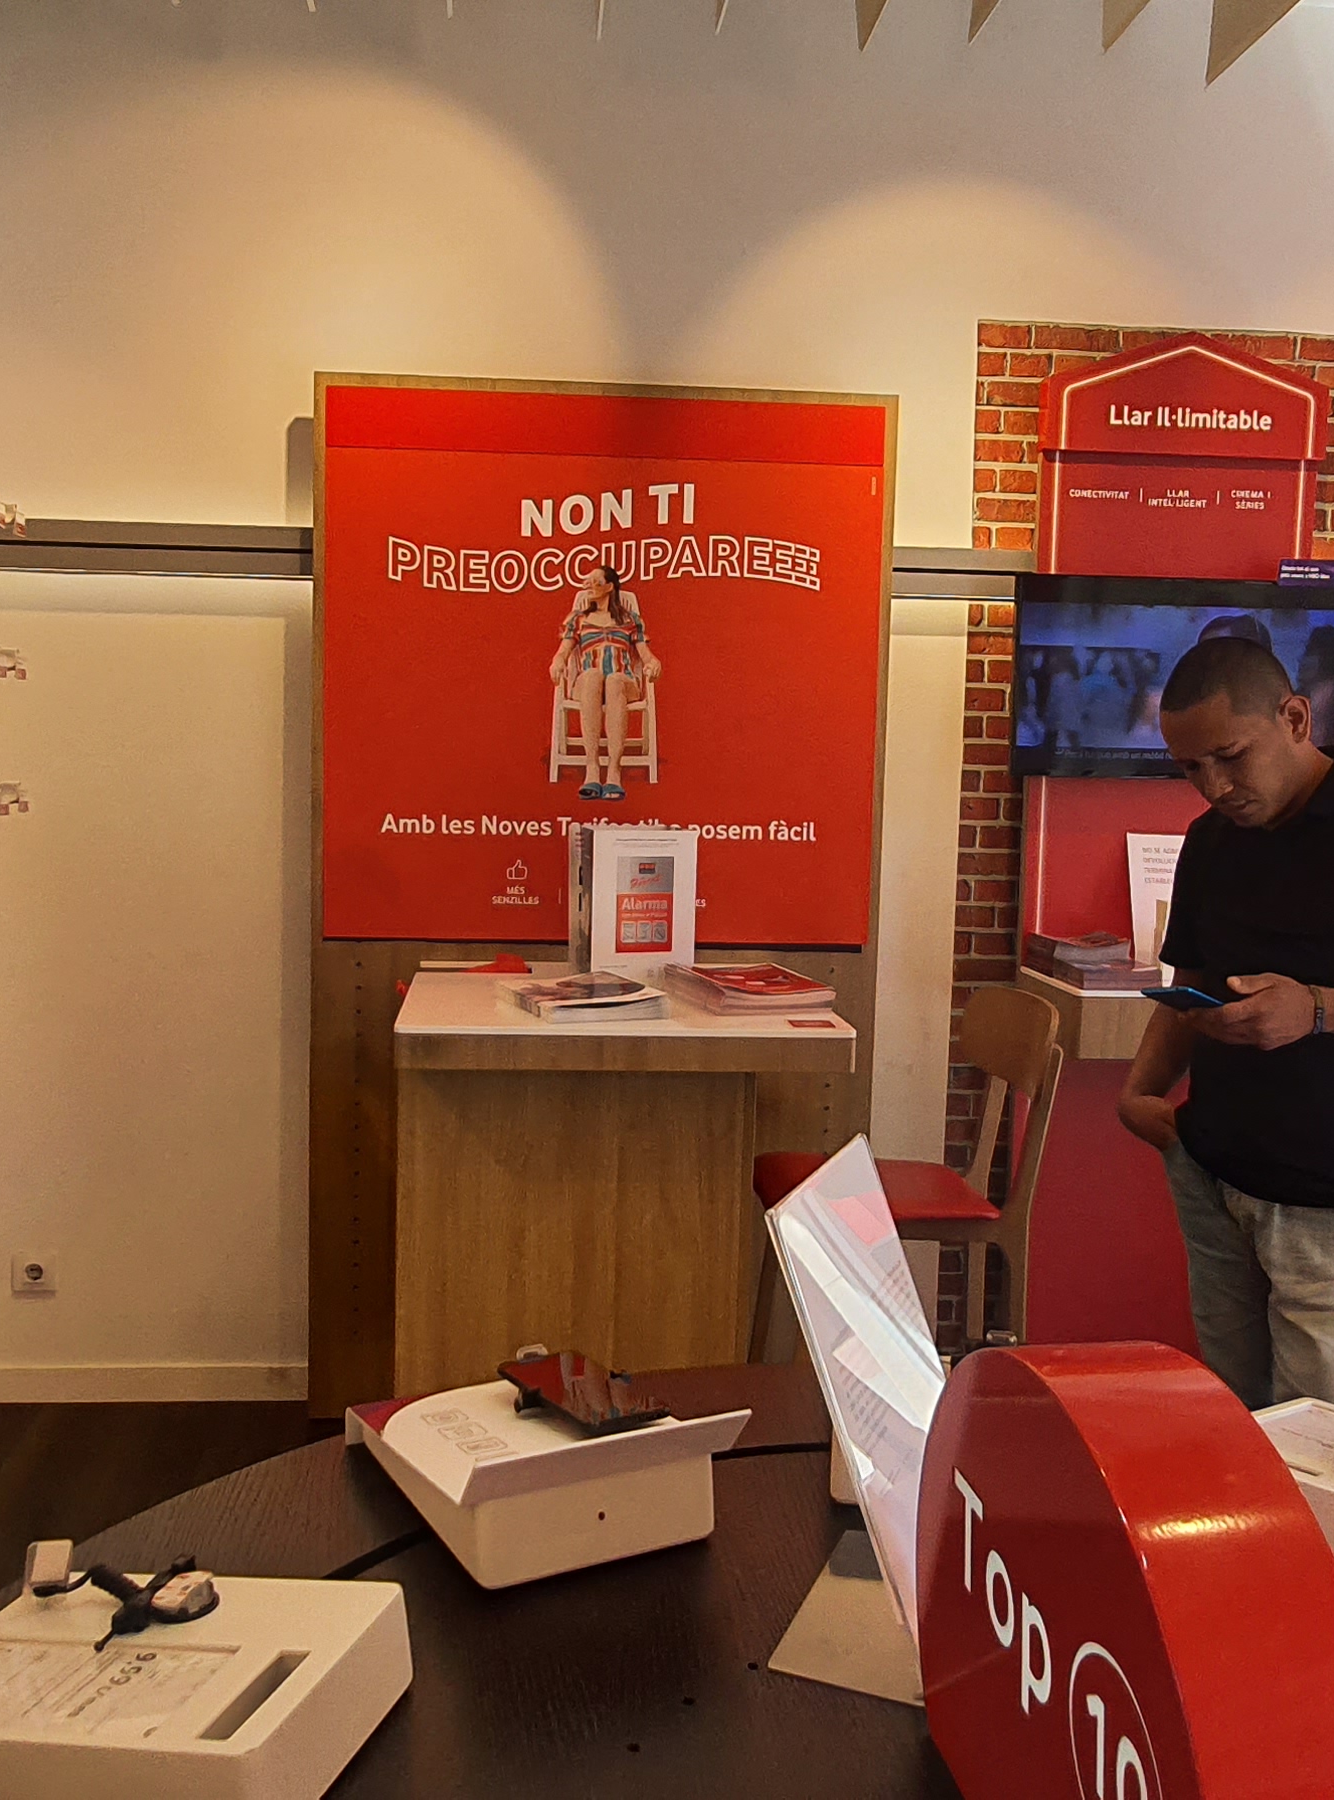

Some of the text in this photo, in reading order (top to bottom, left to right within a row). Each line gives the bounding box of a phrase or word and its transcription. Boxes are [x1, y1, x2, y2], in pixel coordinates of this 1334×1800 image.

[1110, 404, 1272, 430] Llar Il·limitable
[1069, 488, 1130, 500] CONECTIVITAT
[1167, 489, 1190, 498] LLAR
[521, 484, 695, 537] NON TI
[381, 813, 435, 834] Amb
[441, 814, 475, 835] les
[481, 815, 552, 837] Noves
[768, 820, 816, 842] fàcil
[953, 1466, 1053, 1716] Top
[1086, 1693, 1148, 1800] 10
